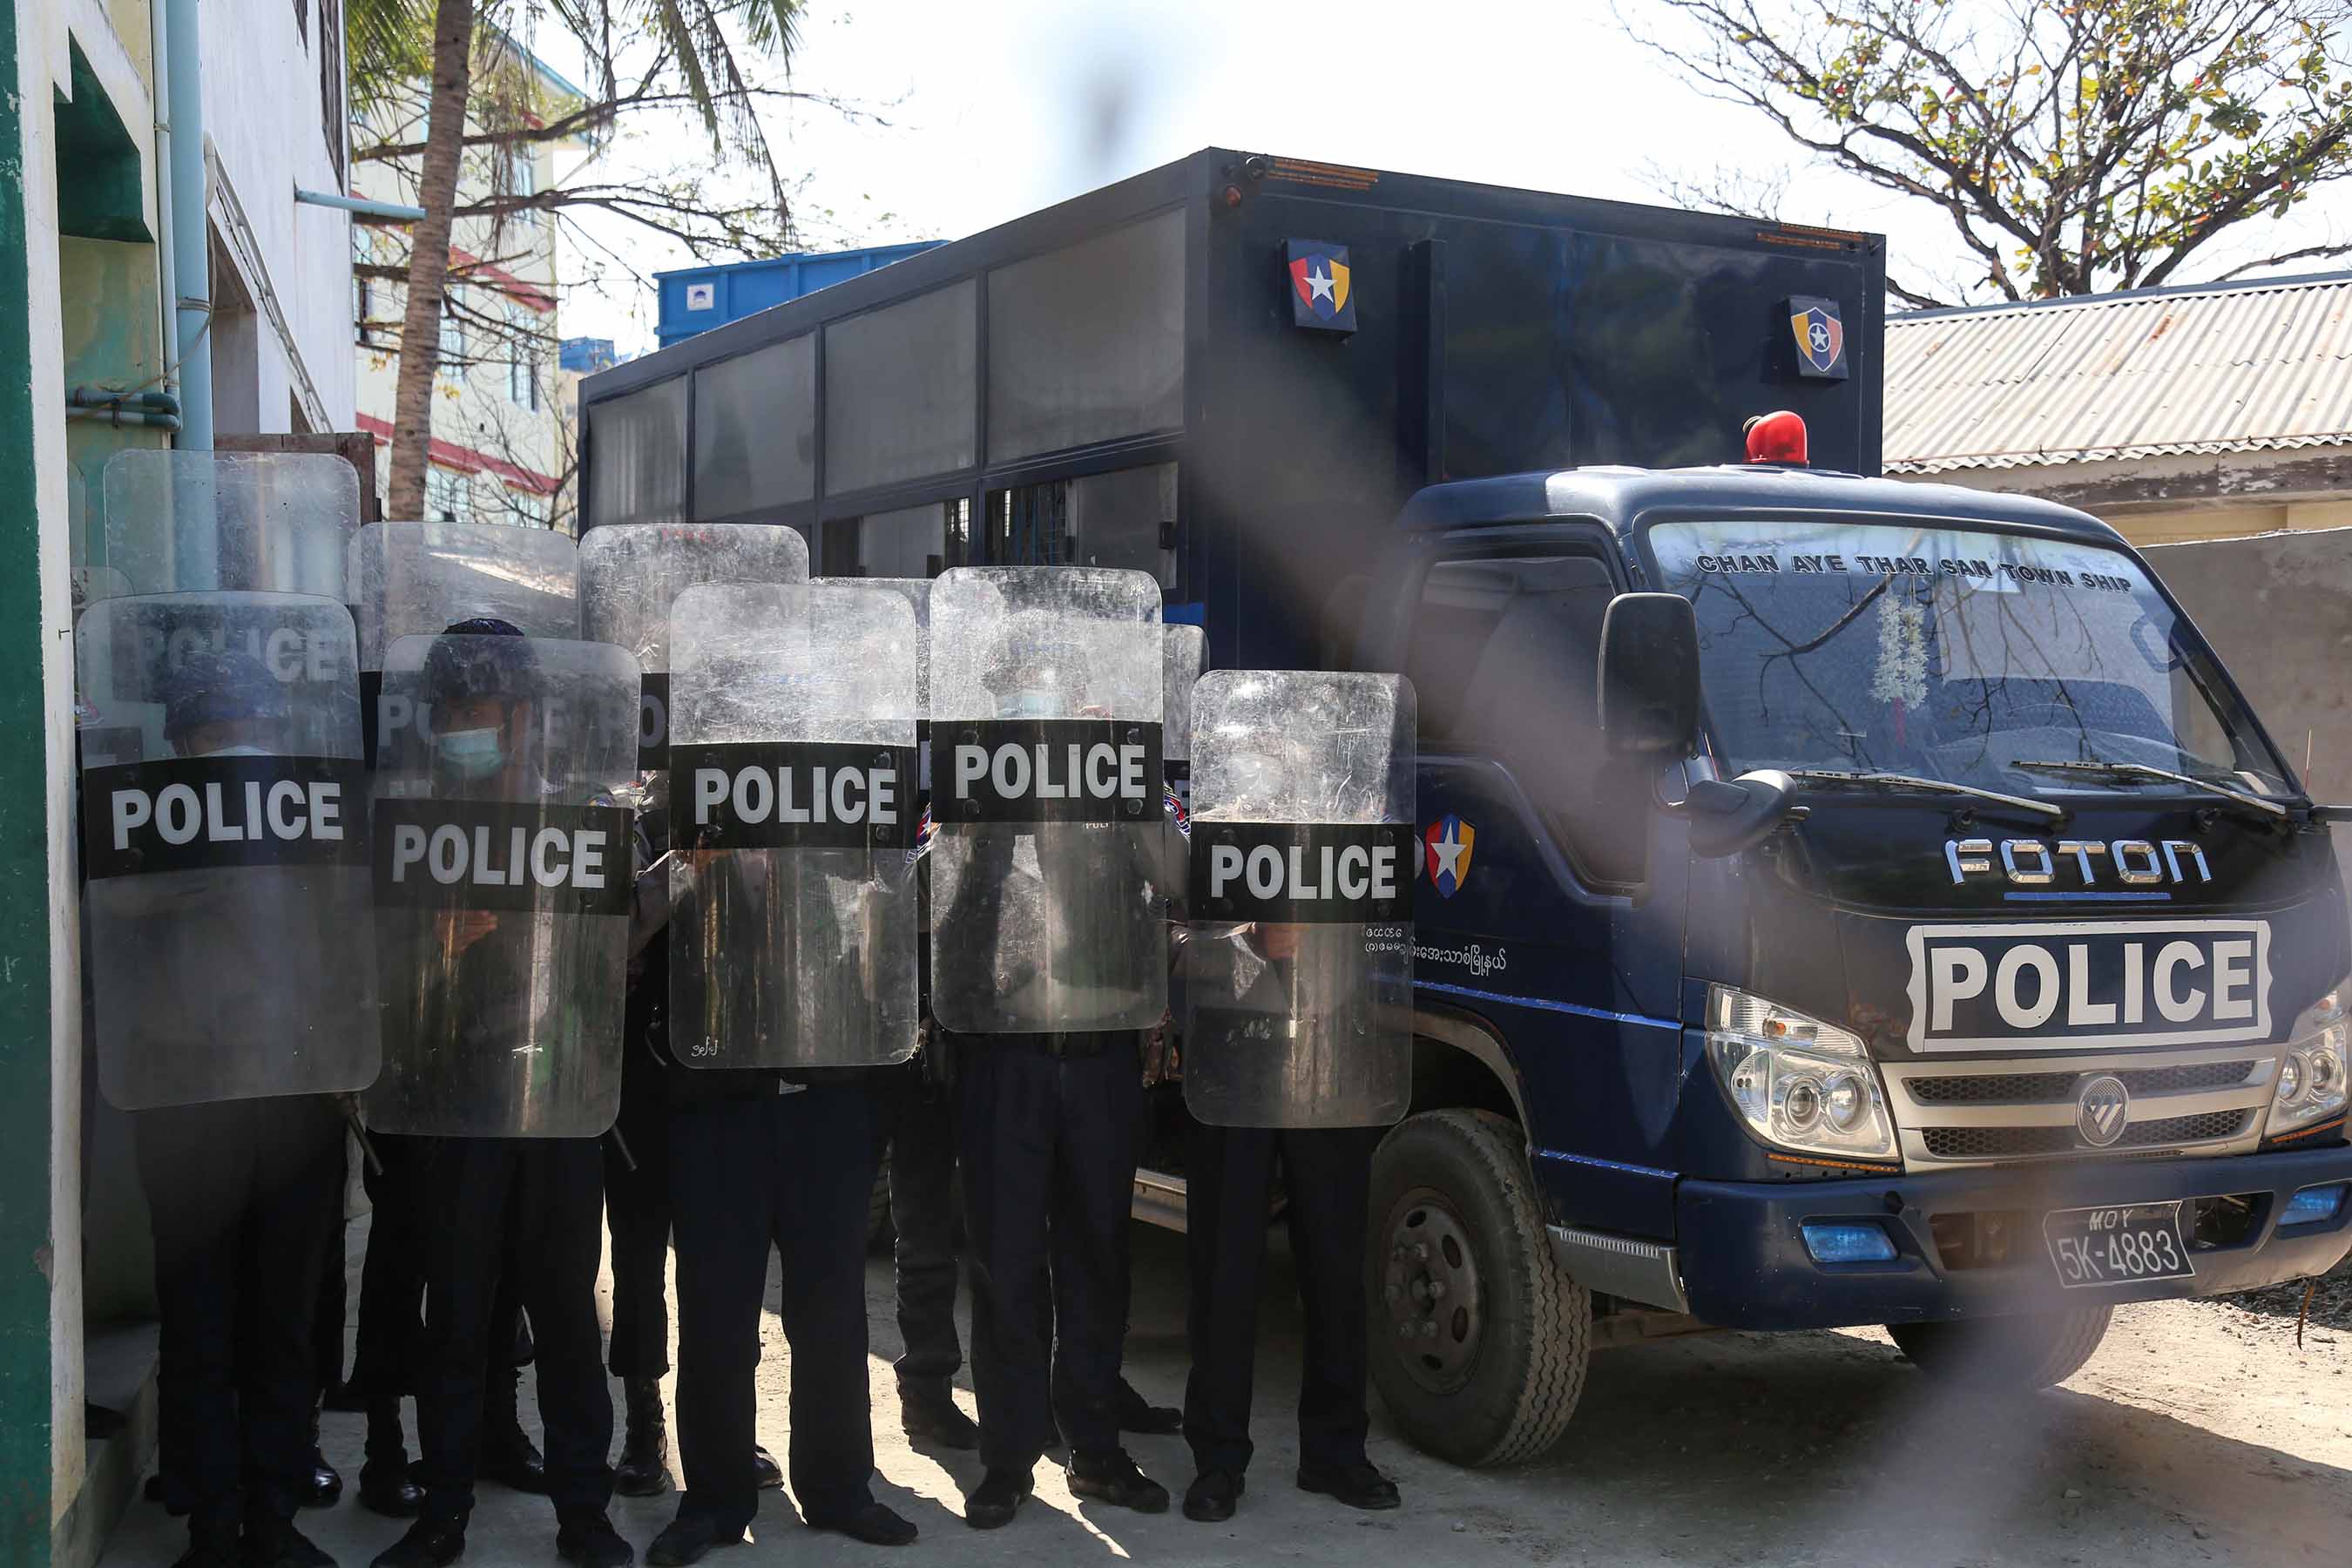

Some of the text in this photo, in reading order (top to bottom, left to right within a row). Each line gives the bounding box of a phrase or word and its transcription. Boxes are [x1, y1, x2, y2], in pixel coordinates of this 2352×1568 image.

[1695, 554, 2132, 594] CHAN AYE THAR SAN TOWN SHIP
[695, 766, 897, 825] POLICE
[955, 742, 1146, 799] POLICE
[112, 781, 344, 849] POLICE
[392, 824, 606, 889] POLICE
[1211, 845, 1396, 900] POLICE
[1943, 838, 2212, 885] FOTON
[1930, 941, 2253, 1031] POLICE
[2058, 1229, 2179, 1281] 5K-4883
